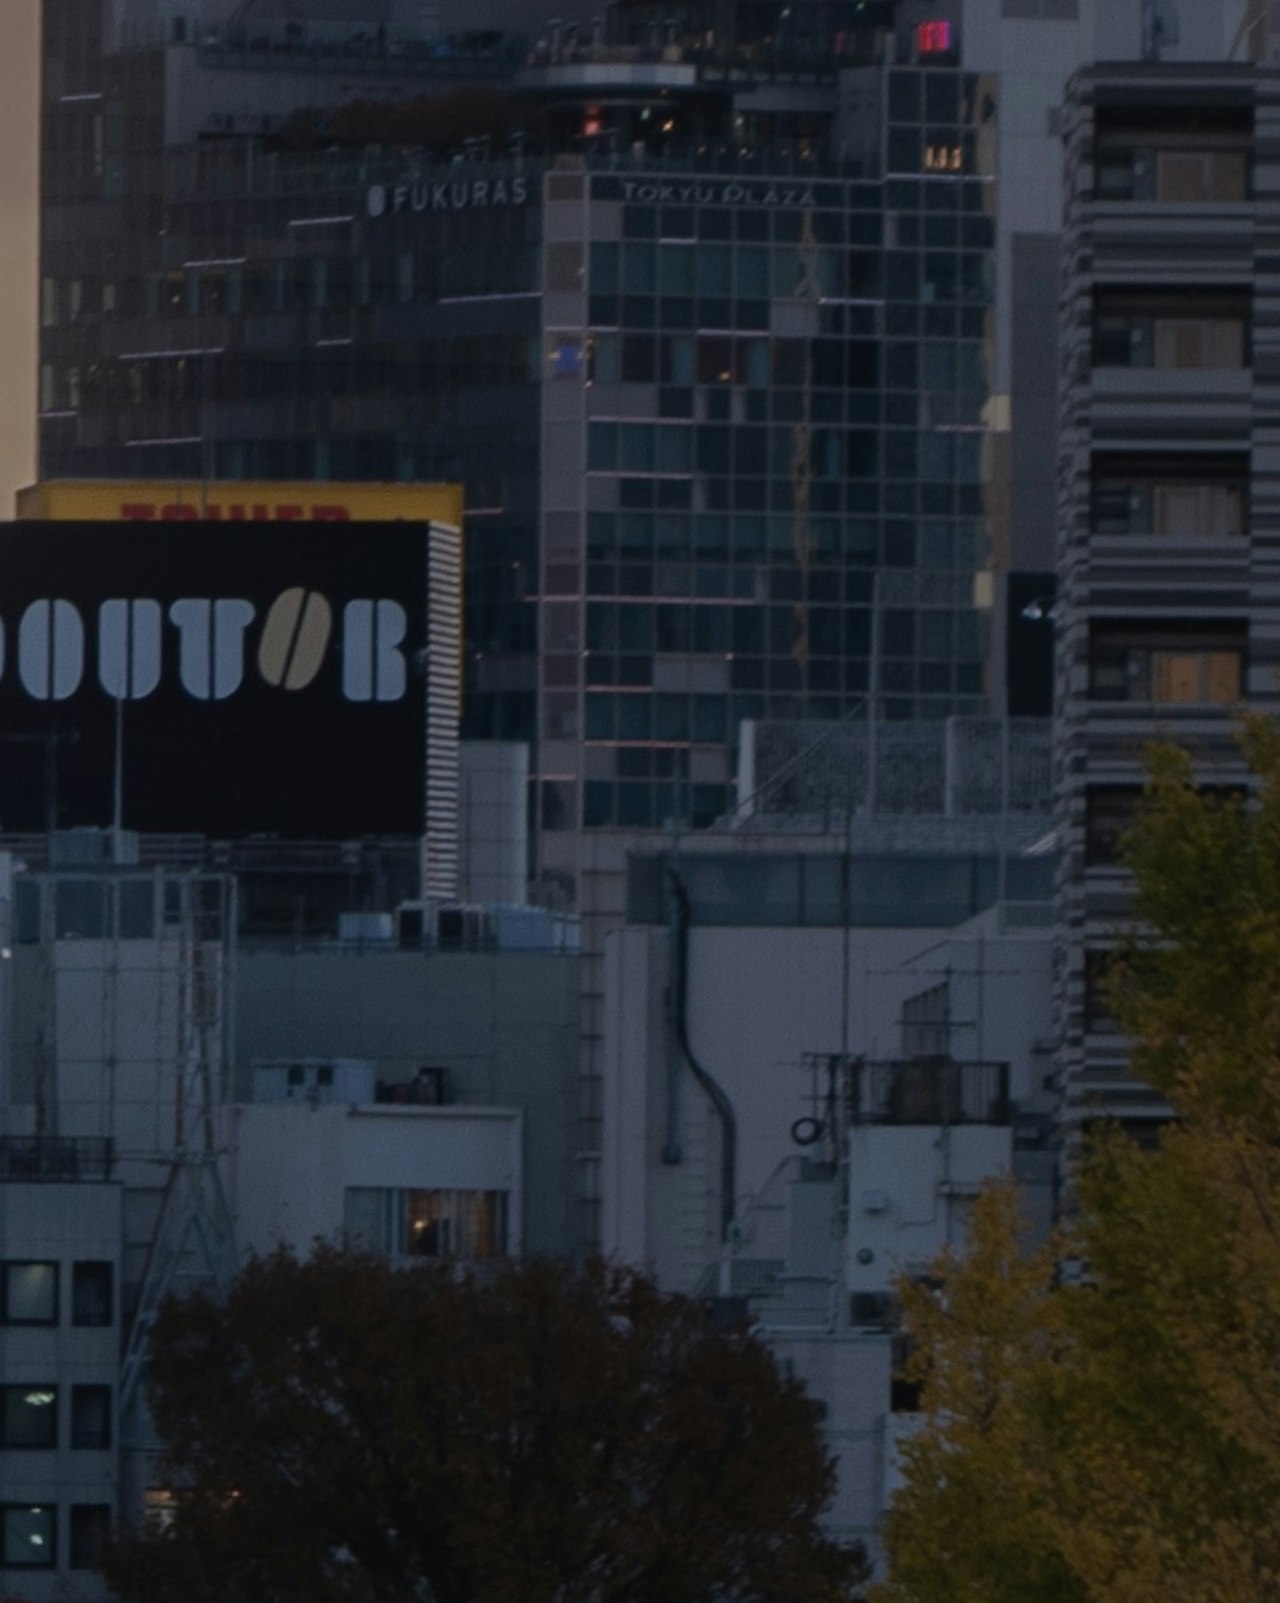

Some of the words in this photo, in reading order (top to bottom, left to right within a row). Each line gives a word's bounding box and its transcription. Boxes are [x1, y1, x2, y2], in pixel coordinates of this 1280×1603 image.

[392, 176, 528, 213] FUKURAS
[622, 181, 714, 203] TOKYU
[720, 184, 818, 206] PLAZA
